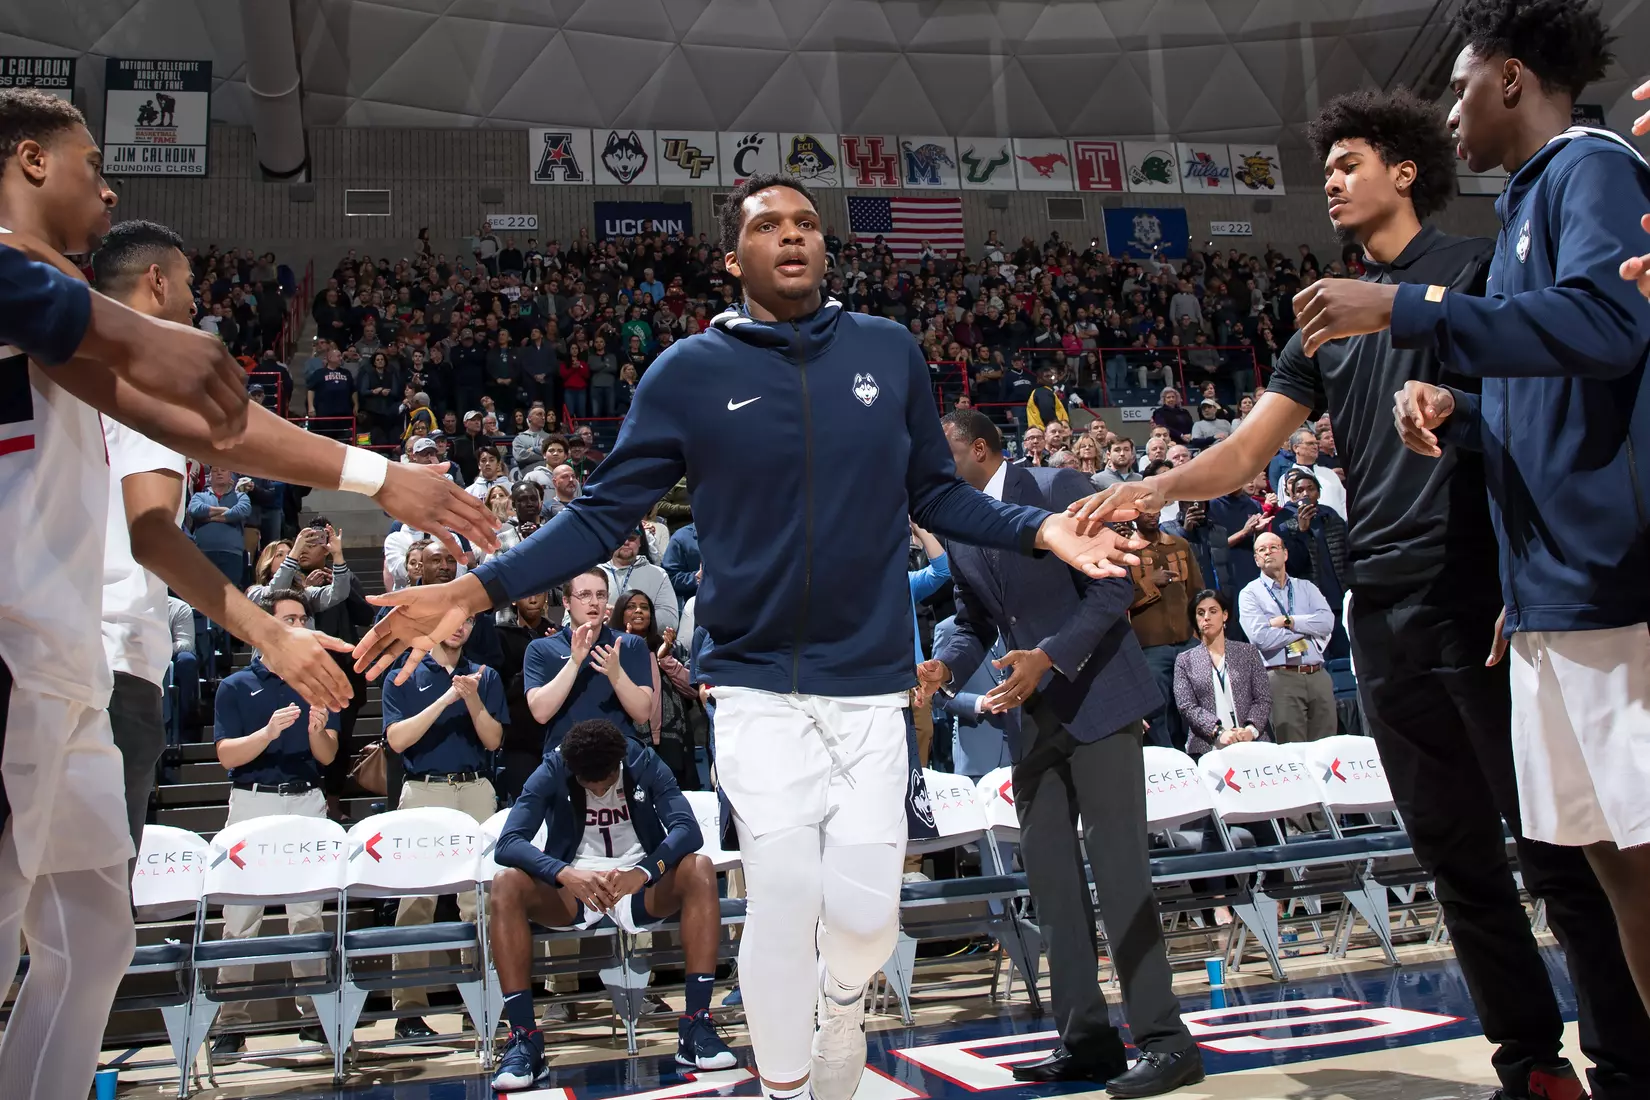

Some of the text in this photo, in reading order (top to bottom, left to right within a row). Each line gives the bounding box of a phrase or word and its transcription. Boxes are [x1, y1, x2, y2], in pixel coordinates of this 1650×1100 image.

[9, 59, 70, 76] CALHOUN
[120, 61, 199, 71] NATIONAL COLLEGIATE
[16, 77, 31, 85] OF
[34, 77, 68, 86] 2005
[137, 71, 181, 80] BASKETBALL
[133, 80, 184, 90] HALL OF FAME
[797, 142, 814, 151] ECU
[114, 147, 196, 163] JIM CALHOUN
[662, 138, 714, 179] UCF
[106, 165, 203, 173] FOUNDING CLASS
[1184, 159, 1230, 178] Tulsa
[488, 216, 537, 228] SEC 220
[605, 219, 683, 235] UCONN
[1229, 223, 1251, 233] 222
[1123, 410, 1142, 418] SEC
[1242, 762, 1306, 779] TICKET
[1348, 759, 1377, 770] TIC
[1148, 768, 1195, 784] CKET
[1248, 774, 1305, 789] GALAX
[1353, 772, 1382, 780] GAL
[1146, 779, 1199, 795] ALAXY
[928, 788, 971, 801] KET
[932, 799, 975, 812] AXY
[585, 804, 630, 826] CON
[257, 840, 343, 855] TICKET
[392, 835, 476, 849] TICKET
[599, 826, 614, 858] 1
[138, 851, 206, 865] ICKET
[257, 853, 341, 866] LAXY
[137, 865, 204, 876] ALAXY
